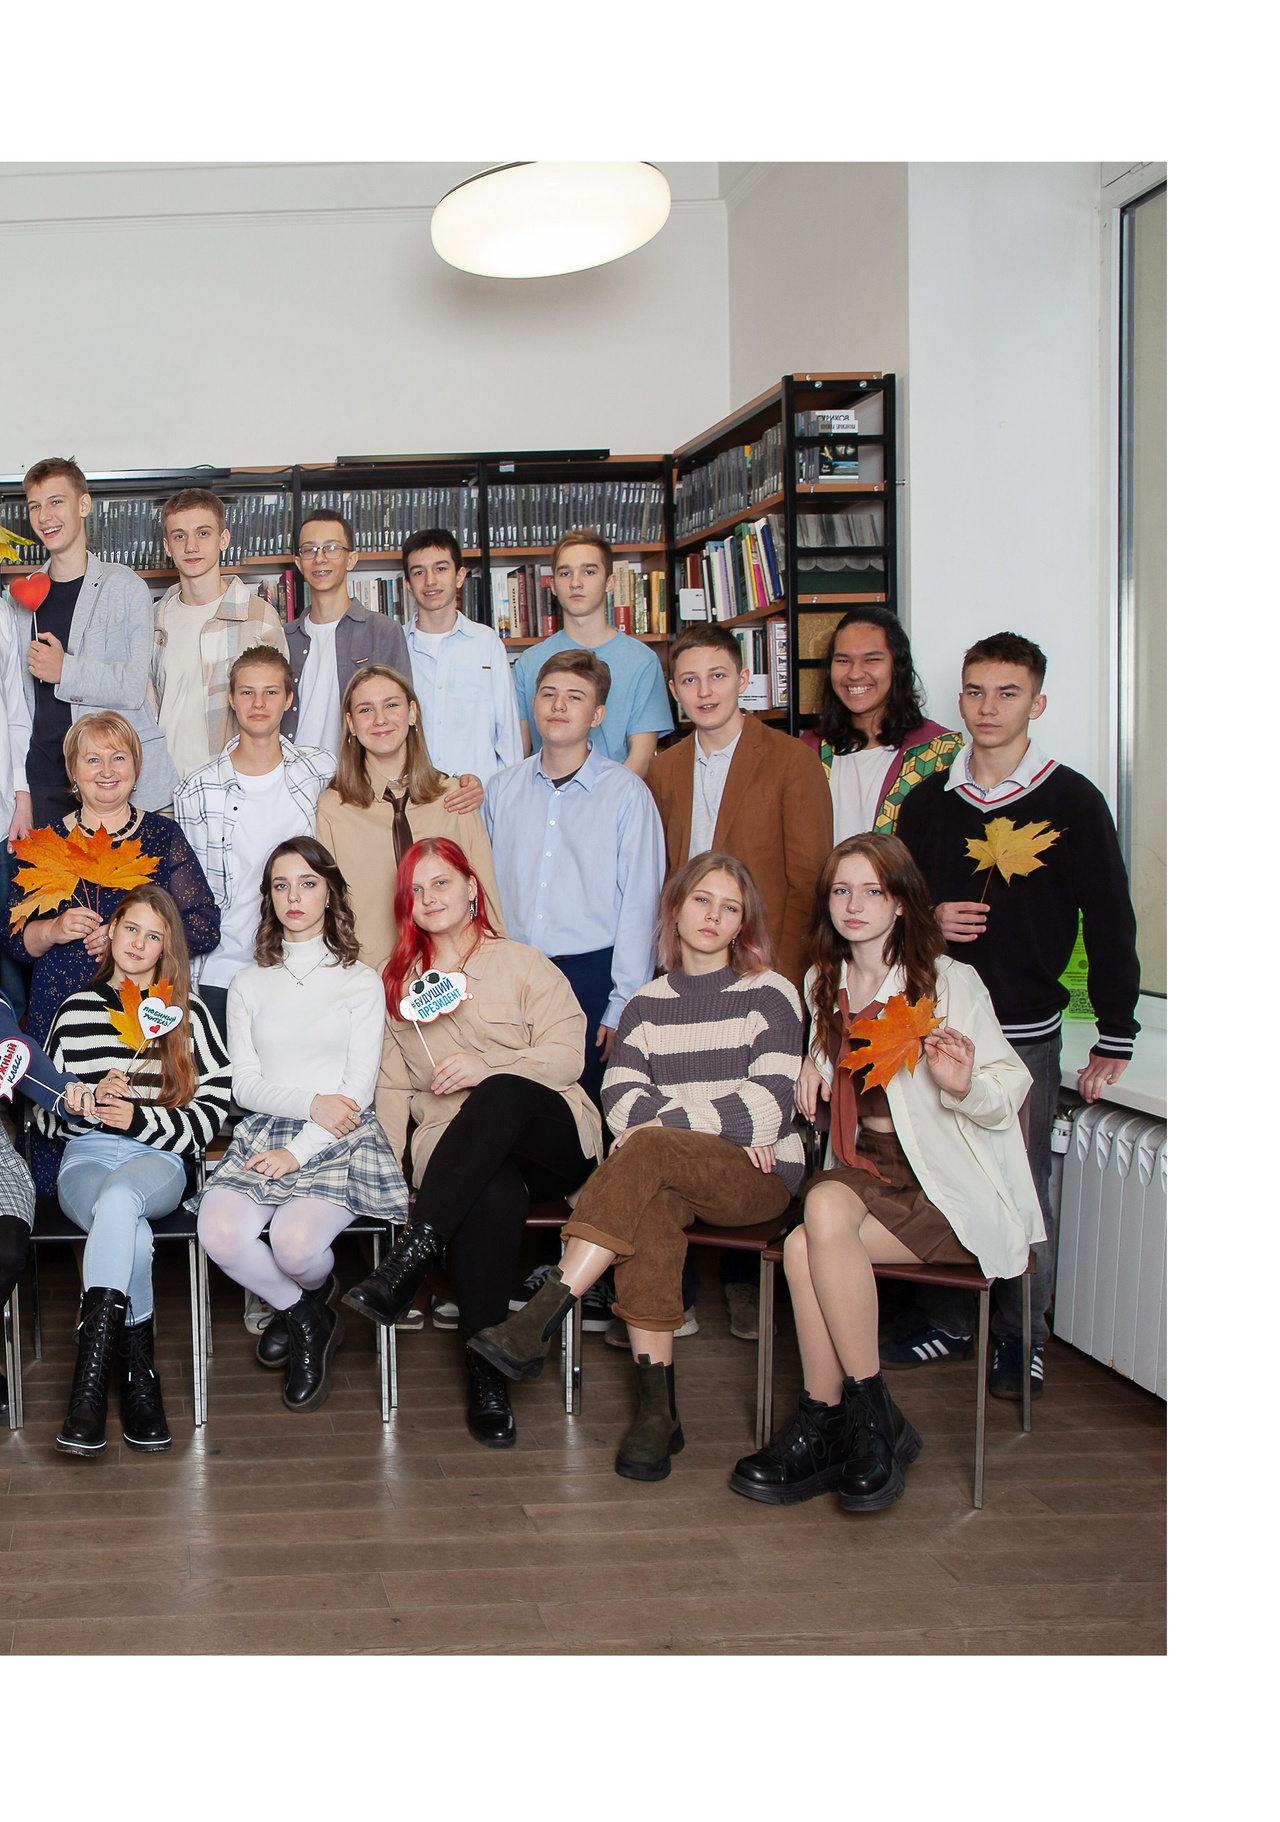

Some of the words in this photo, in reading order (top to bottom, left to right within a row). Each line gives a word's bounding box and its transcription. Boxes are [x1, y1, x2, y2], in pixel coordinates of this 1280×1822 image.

[411, 977, 454, 1009] #БУДУЩИЙ
[417, 988, 462, 1019] ПРЕЗИДЕНТ
[143, 1006, 176, 1022] ЛЮБИМЫЙ
